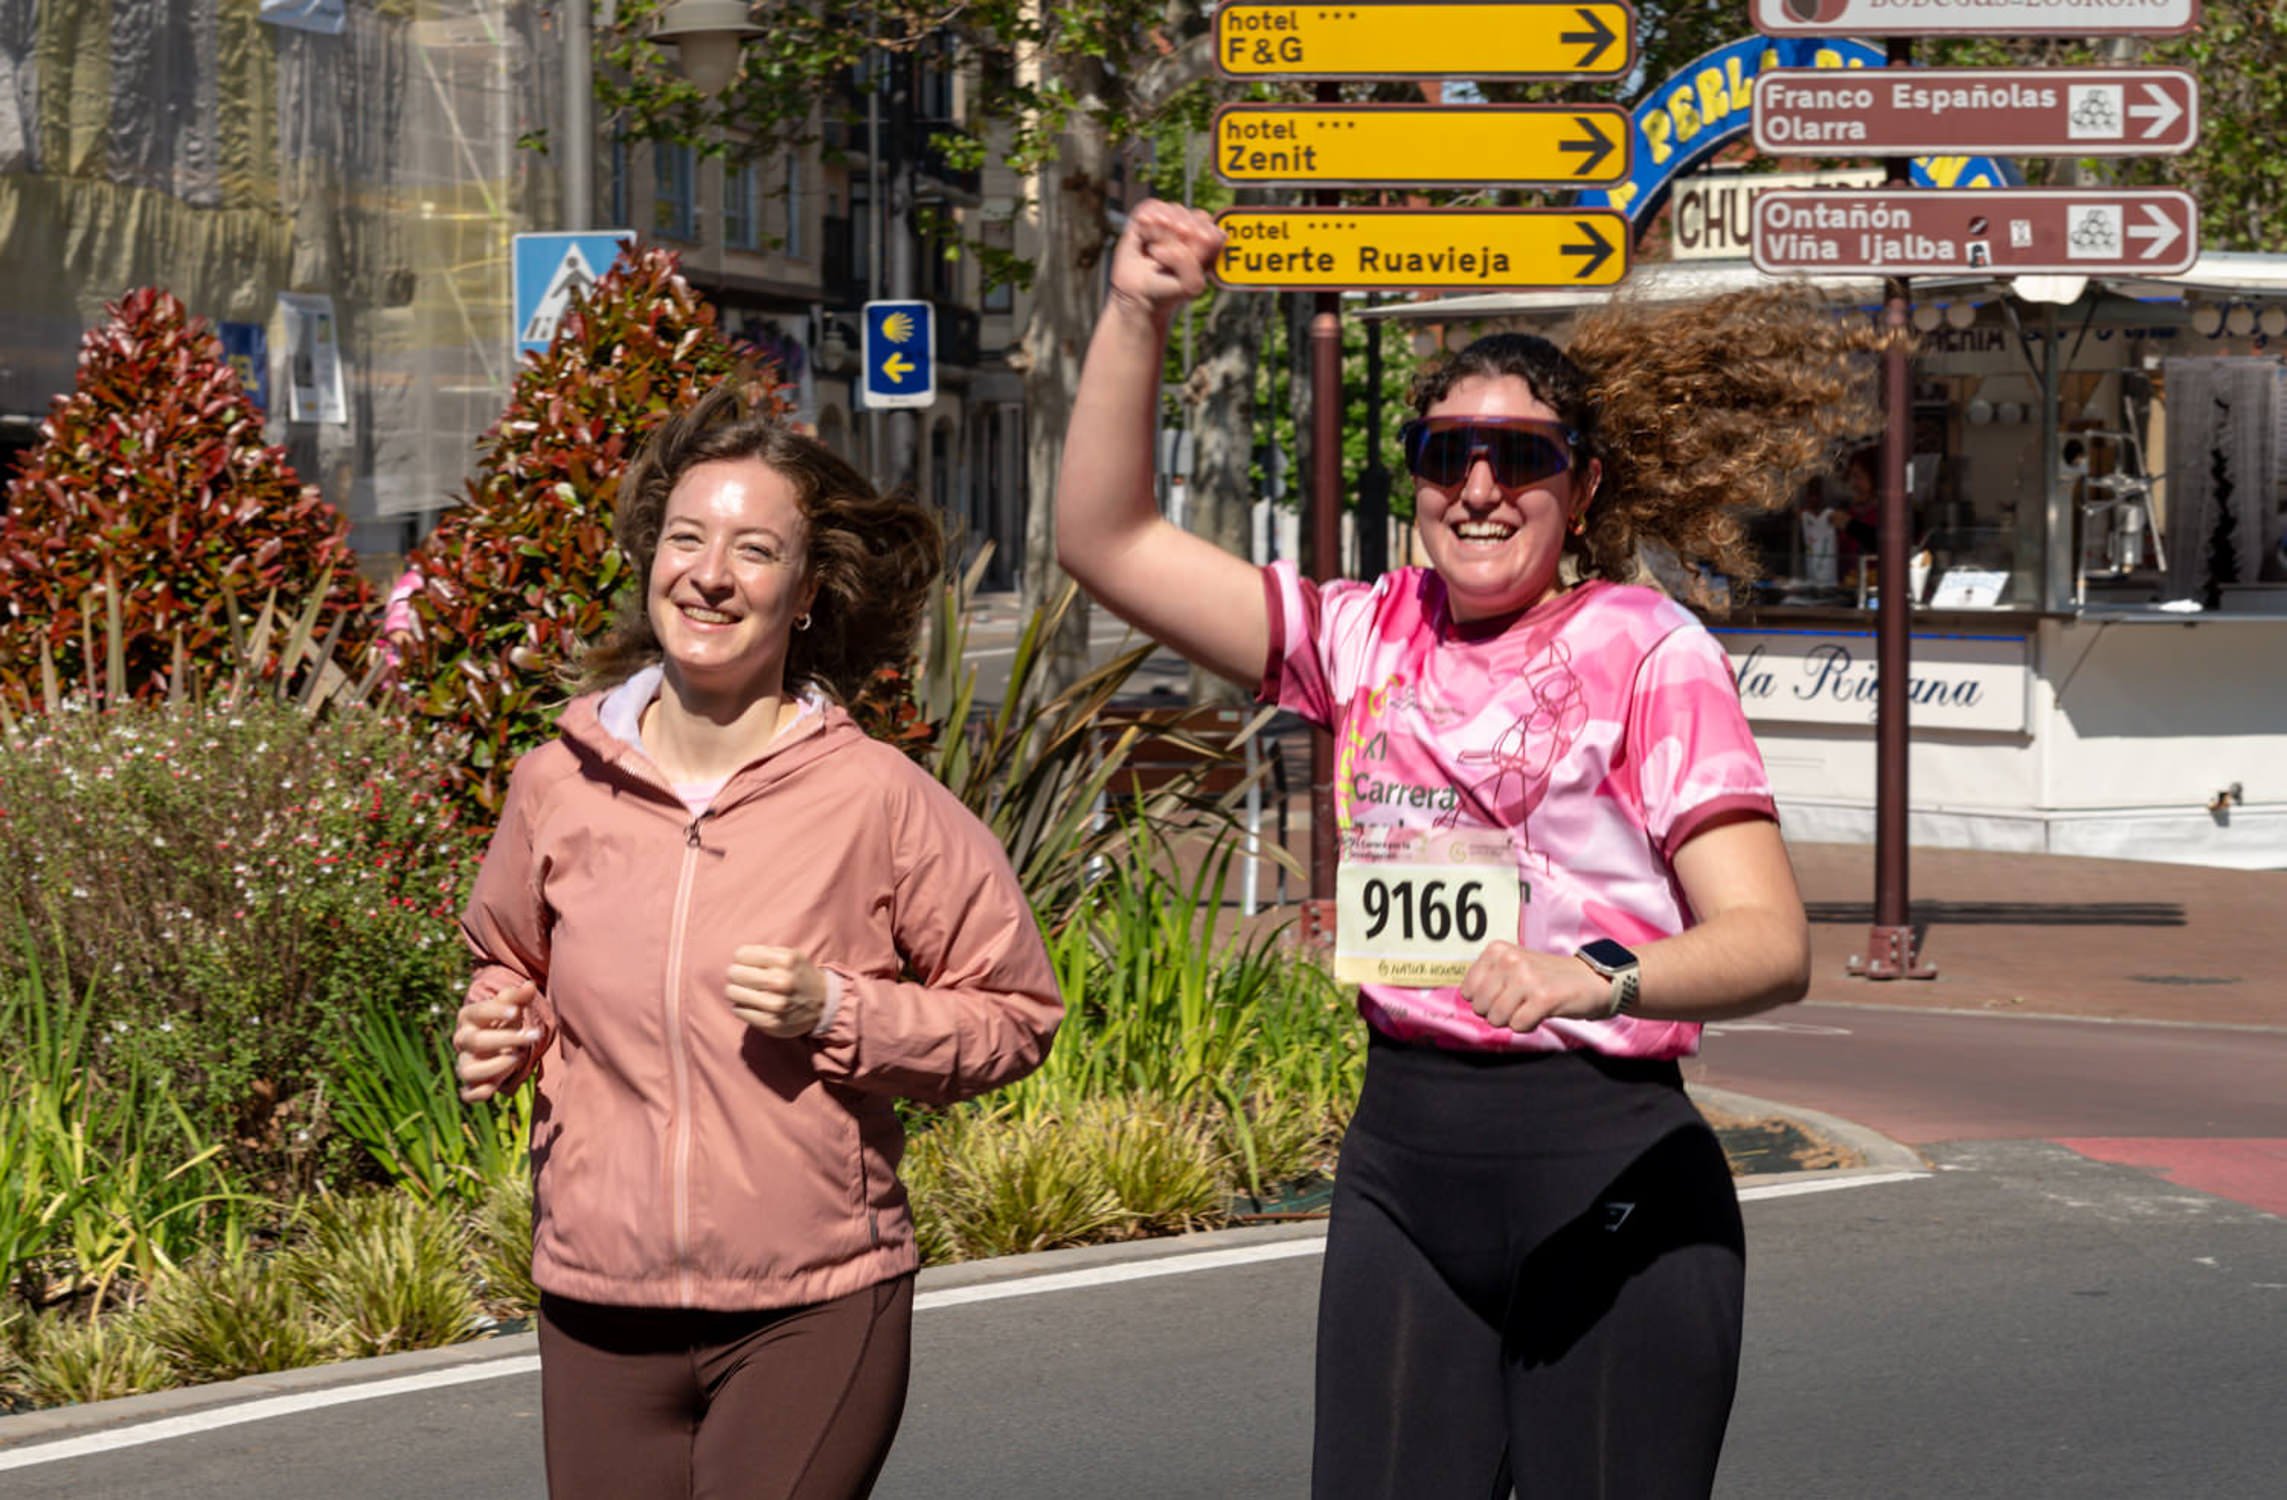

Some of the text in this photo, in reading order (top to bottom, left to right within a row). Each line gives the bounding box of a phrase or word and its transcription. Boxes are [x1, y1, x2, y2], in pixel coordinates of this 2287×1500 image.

[1228, 10, 1299, 31] hotel
[1228, 37, 1303, 64] F&G
[1765, 83, 2058, 115] Franco Españolas
[1226, 118, 1297, 140] hotel
[1765, 115, 1867, 140] Olarra
[1226, 145, 1317, 172] Zenit
[1765, 201, 1911, 229] Ontañón
[1224, 221, 1290, 240] hotel
[1223, 246, 1510, 278] Fuerte Ruavieja
[1766, 233, 1957, 266] Viña Ijalba
[1353, 772, 1456, 811] Carrera
[1362, 878, 1488, 942] 9166
